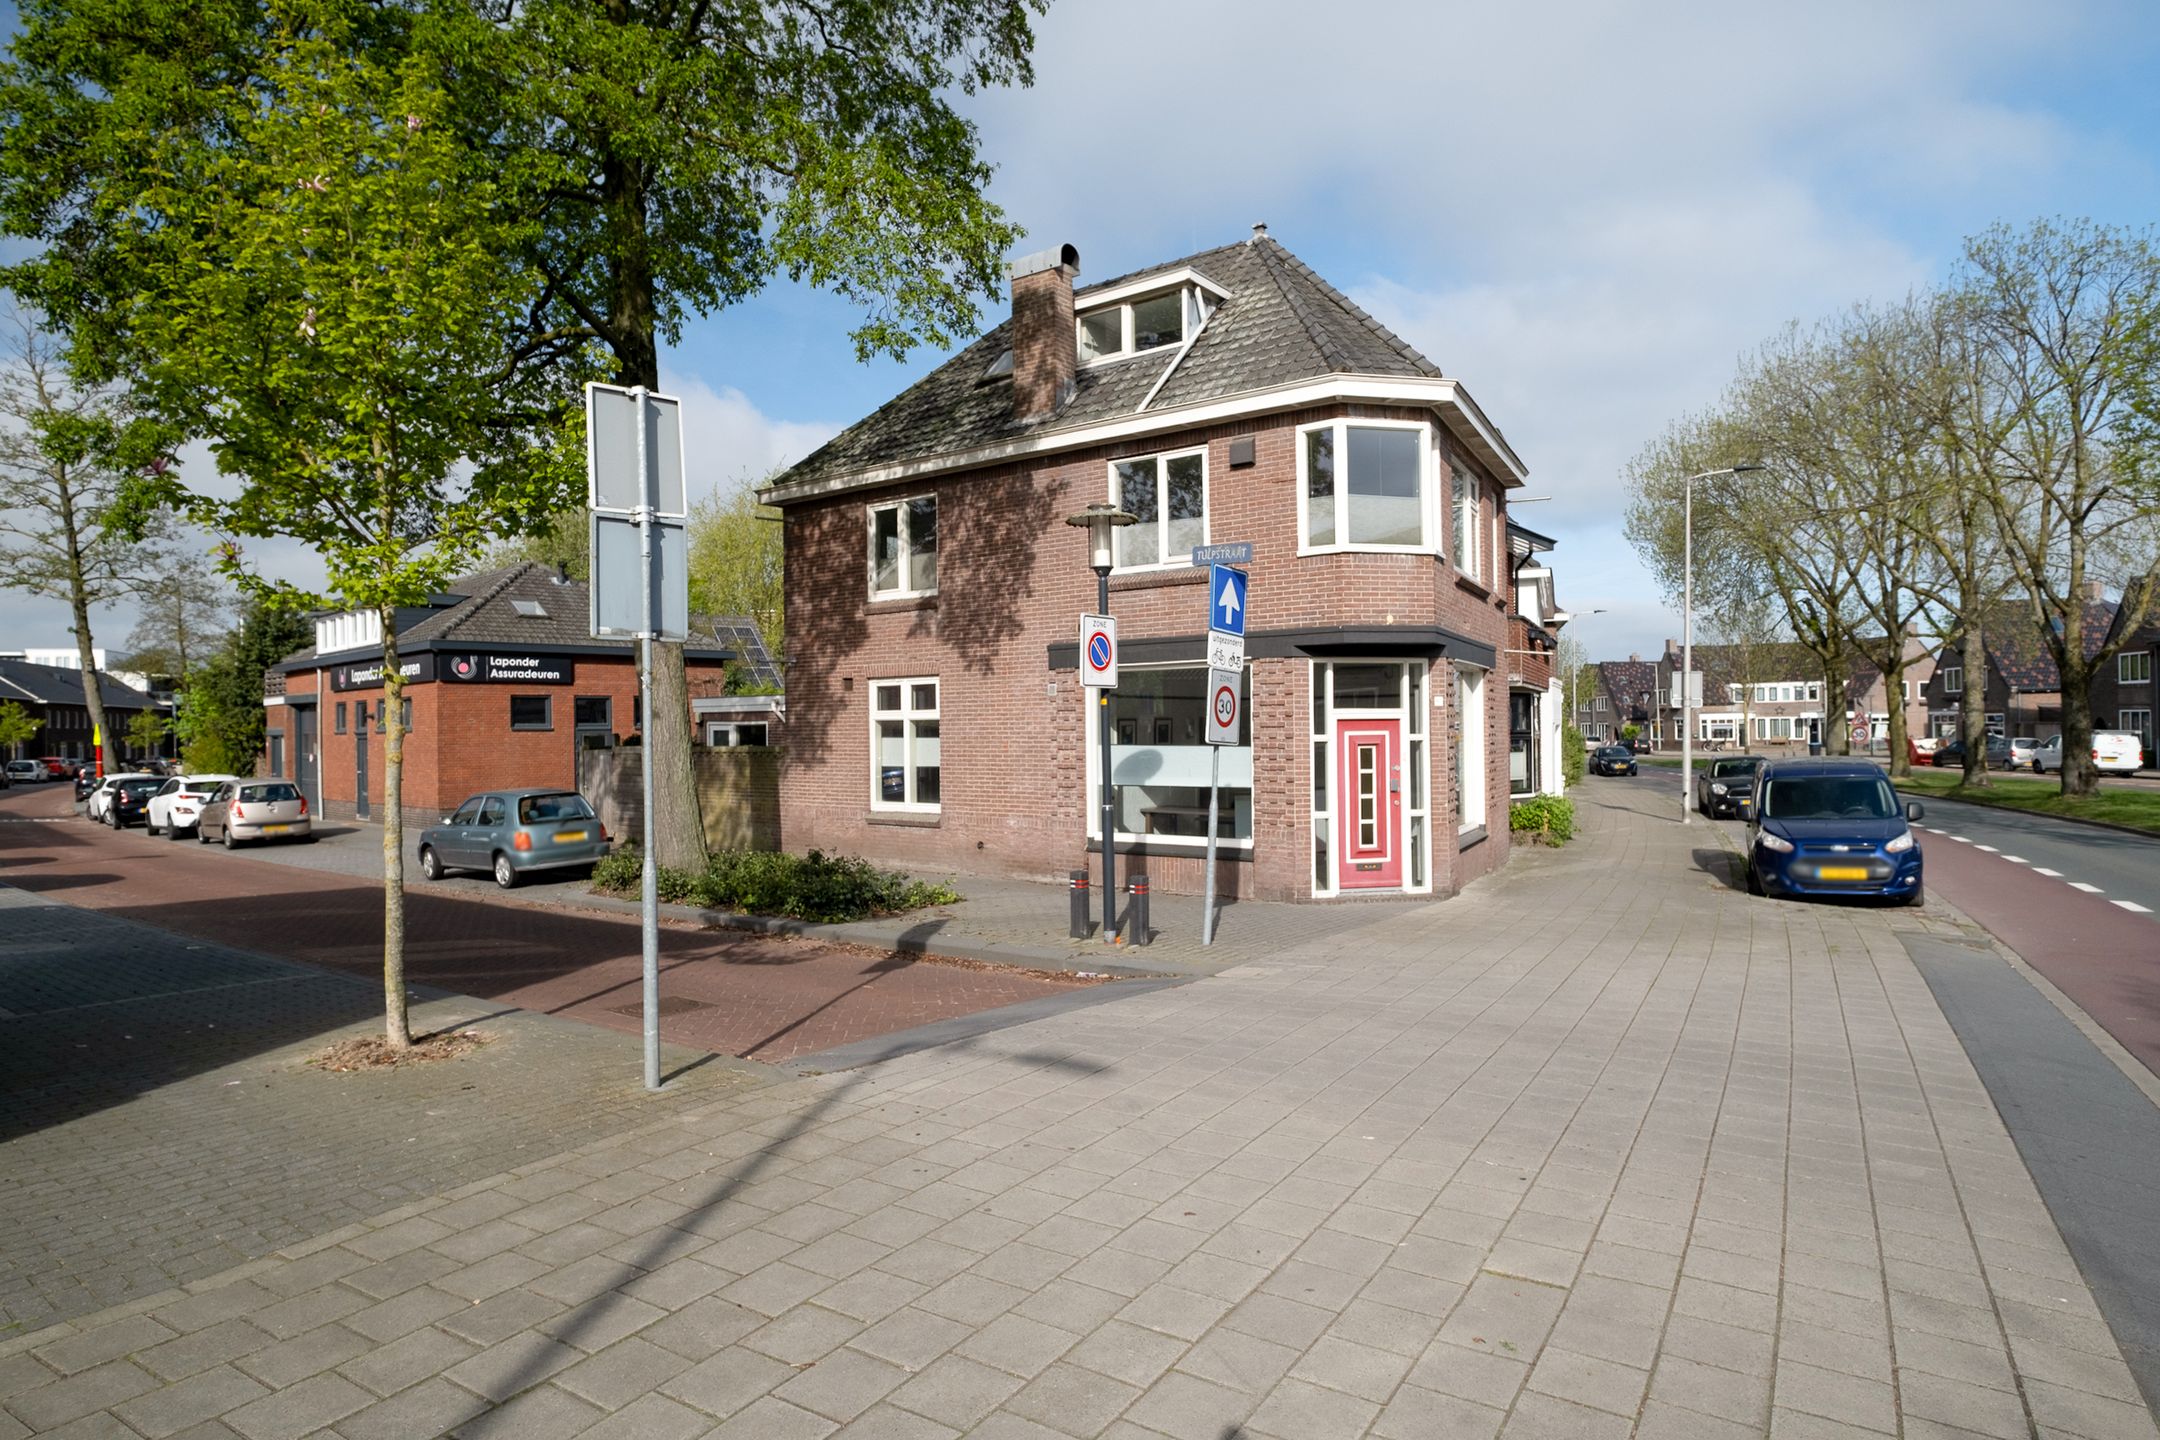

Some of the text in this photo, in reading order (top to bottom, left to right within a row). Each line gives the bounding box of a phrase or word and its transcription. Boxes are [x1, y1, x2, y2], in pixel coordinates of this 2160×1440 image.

[1197, 546, 1247, 560] TULPSTRAAT
[1093, 620, 1107, 628] ZONE
[490, 656, 539, 667] Laponder
[490, 669, 560, 679] Assuradeuren
[1219, 674, 1233, 683] ZONE
[1218, 699, 1232, 715] 30
